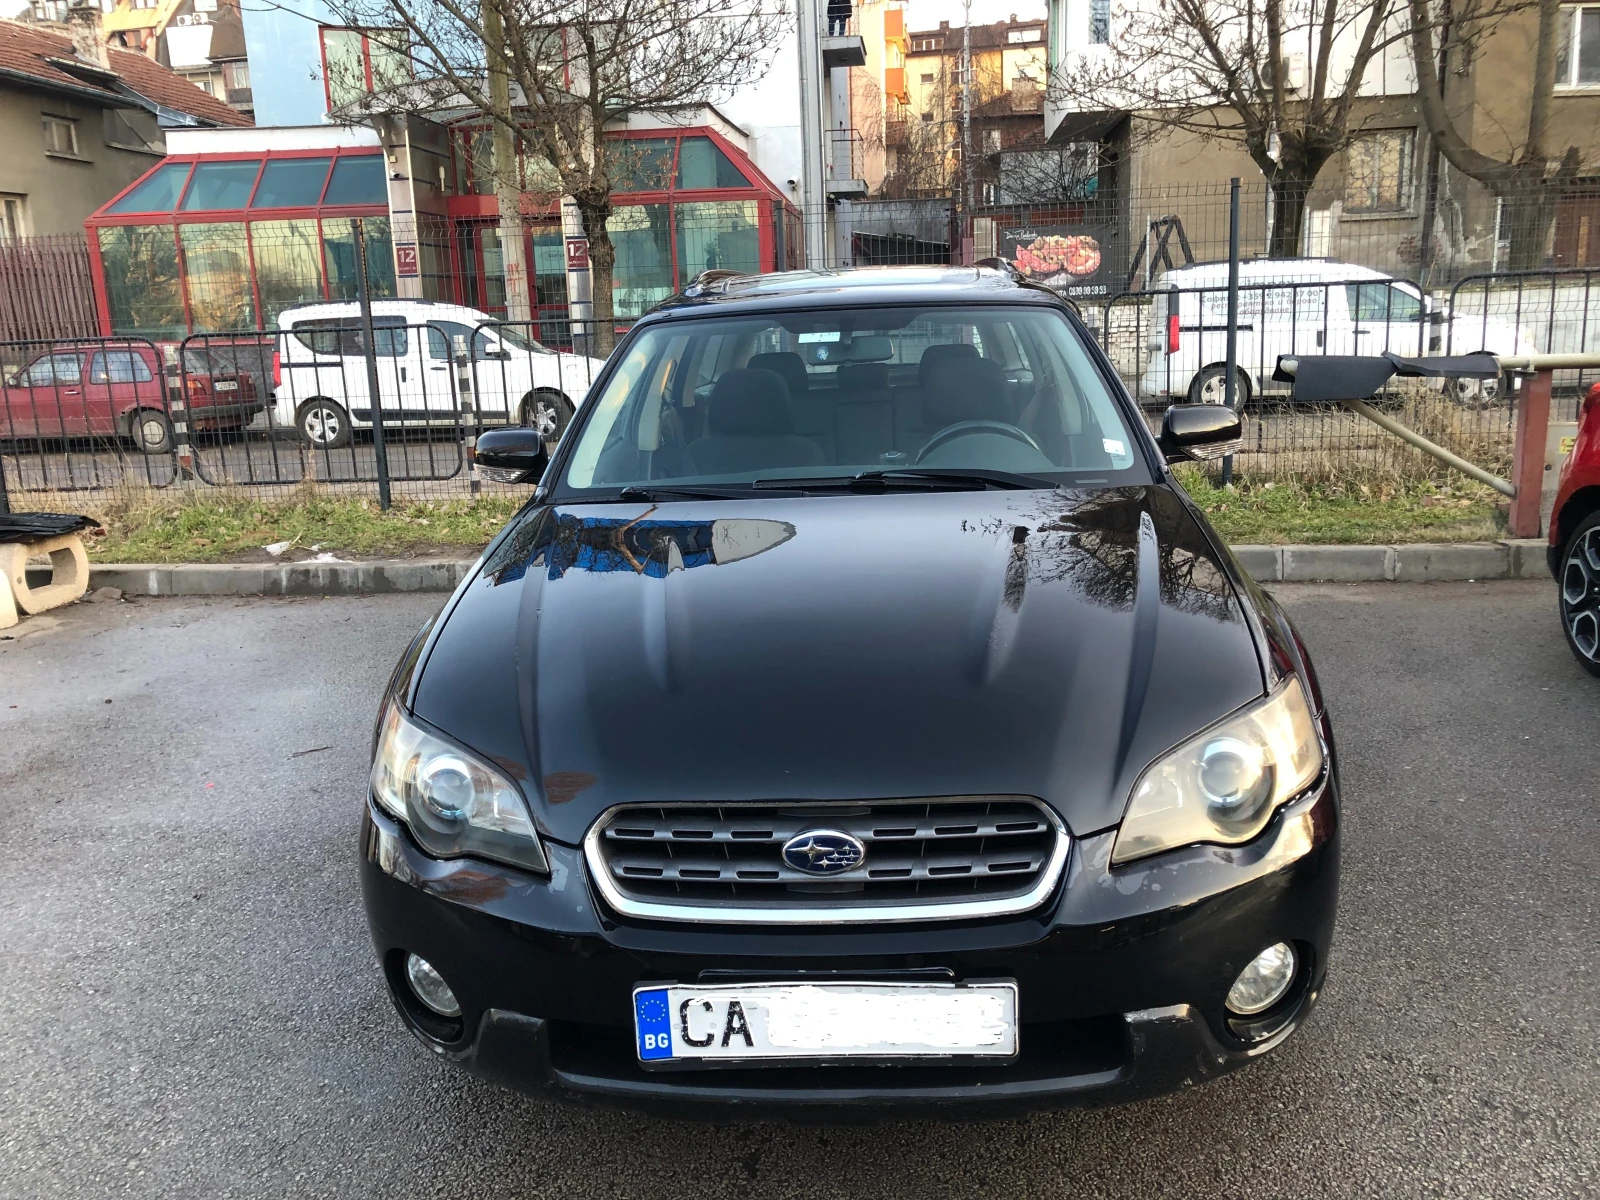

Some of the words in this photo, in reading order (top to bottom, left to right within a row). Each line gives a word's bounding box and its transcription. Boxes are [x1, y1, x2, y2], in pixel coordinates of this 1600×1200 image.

[398, 250, 415, 263] 12
[568, 243, 586, 257] 12
[1286, 297, 1318, 306] брово
[679, 998, 755, 1048] CA
[644, 1033, 669, 1049] BG
